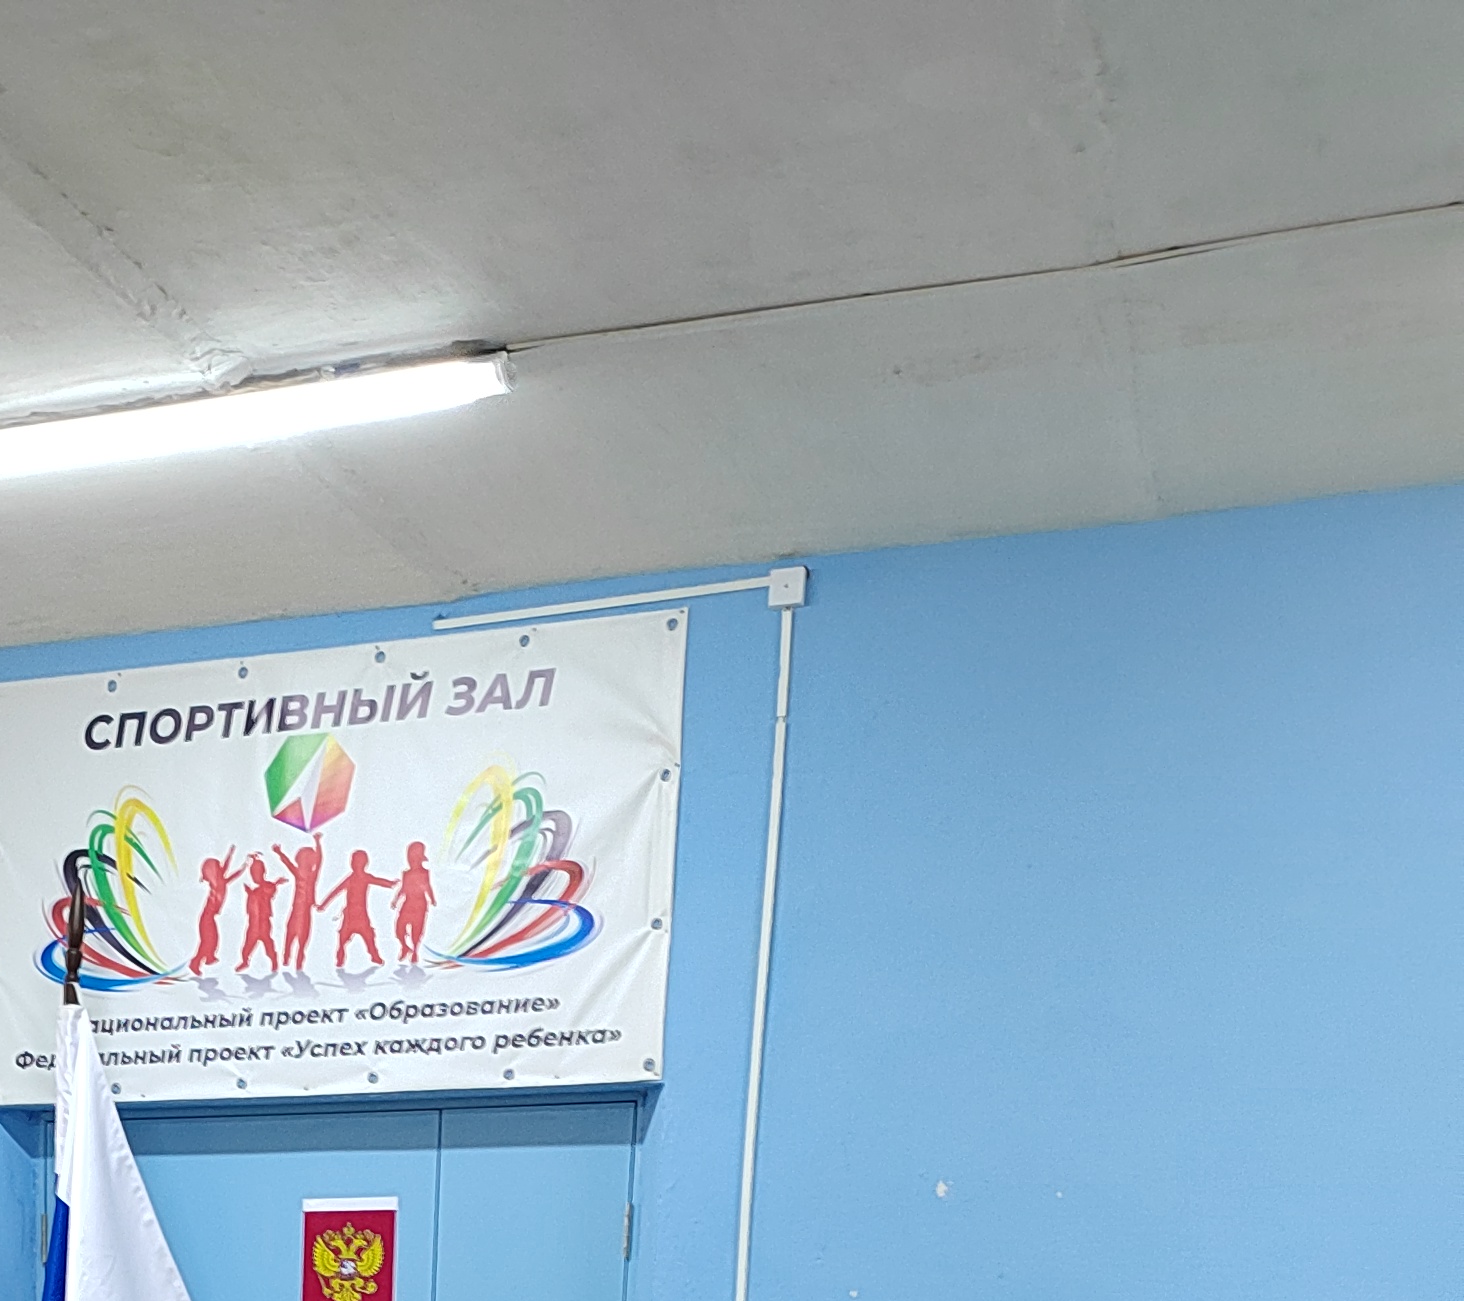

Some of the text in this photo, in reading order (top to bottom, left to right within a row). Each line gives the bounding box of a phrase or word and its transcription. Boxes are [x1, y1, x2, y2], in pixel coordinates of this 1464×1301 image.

[84, 667, 556, 751] СПОРТИВНЫЙ ЗАЛ
[89, 995, 561, 1035] ациональный проект «Образование»
[14, 1027, 623, 1071] Федльный проект «Успех каждого ребенка»
